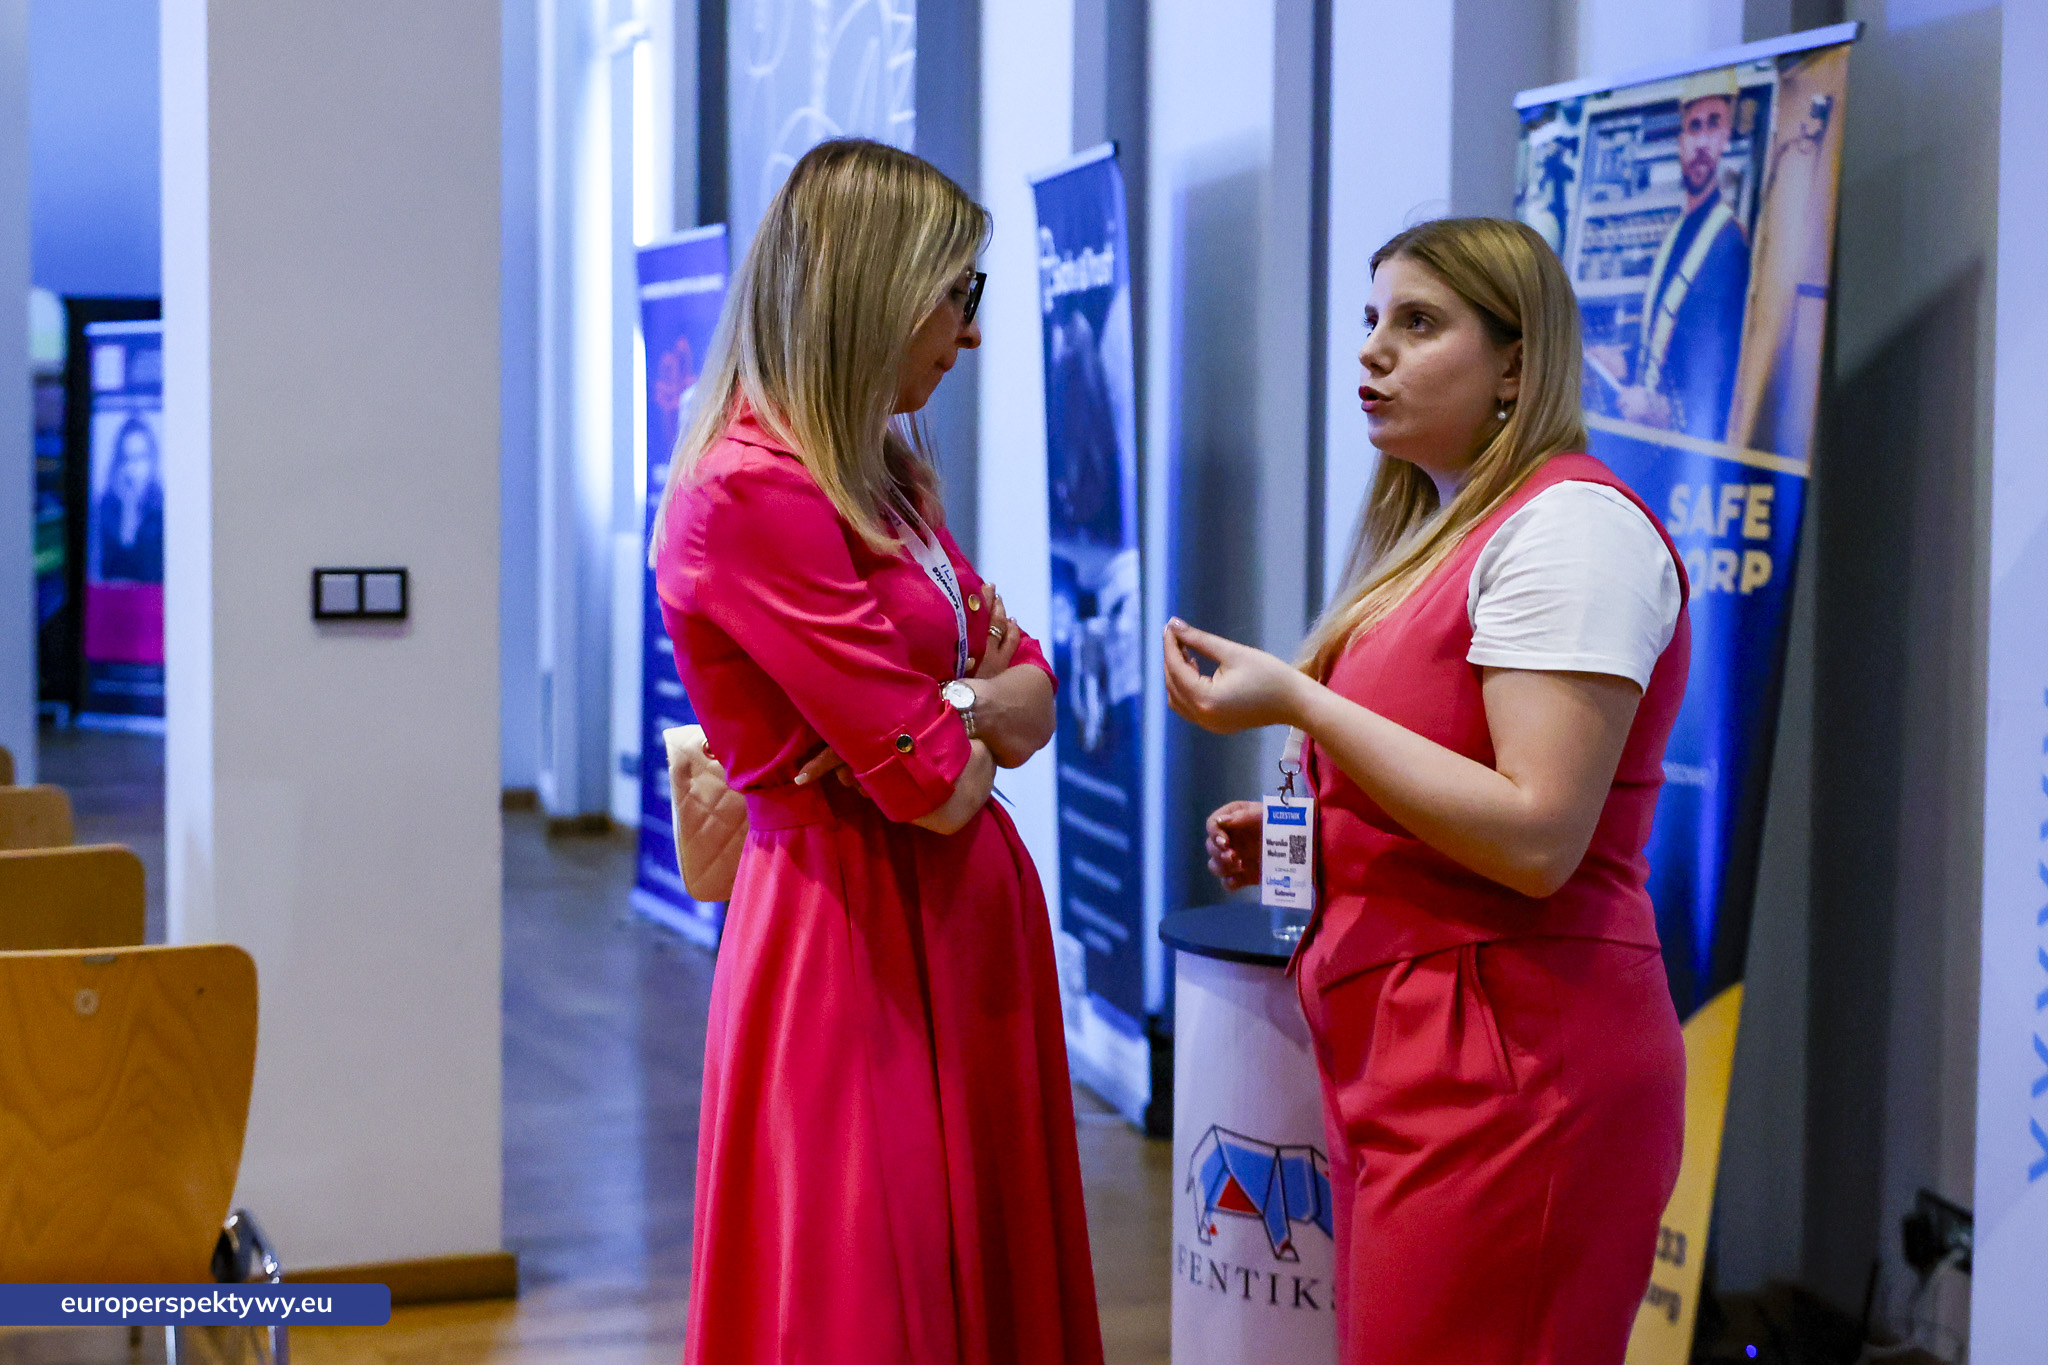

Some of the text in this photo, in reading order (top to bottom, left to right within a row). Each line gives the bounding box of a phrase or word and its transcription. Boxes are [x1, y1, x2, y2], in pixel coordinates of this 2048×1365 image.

[1666, 483, 1774, 539] SAFE
[932, 566, 960, 610] Katowice
[1685, 547, 1773, 598] ORP
